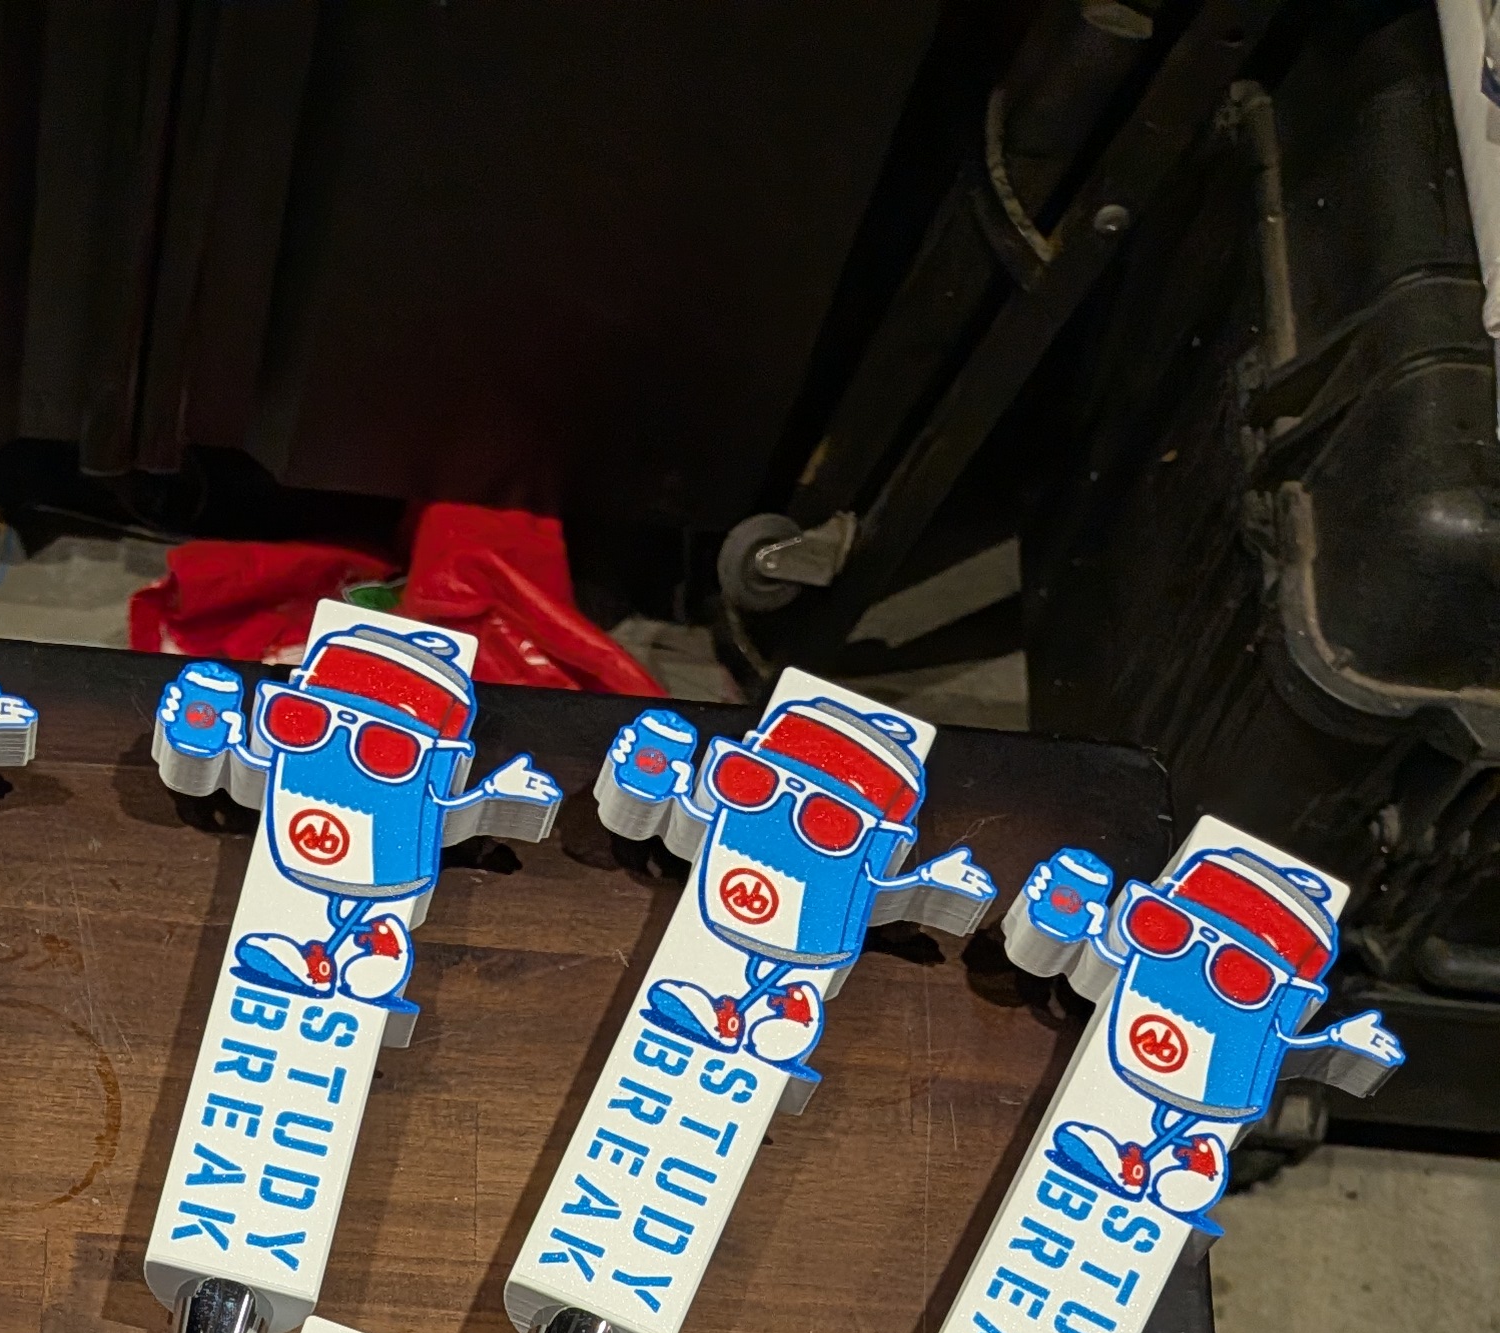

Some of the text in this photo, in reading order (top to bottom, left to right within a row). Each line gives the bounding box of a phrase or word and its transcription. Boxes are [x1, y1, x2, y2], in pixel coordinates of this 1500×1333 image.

[172, 982, 290, 1251] BREAK
[245, 997, 359, 1271] STUDY
[539, 1028, 690, 1282] BREAK
[611, 1053, 758, 1313] STUDY
